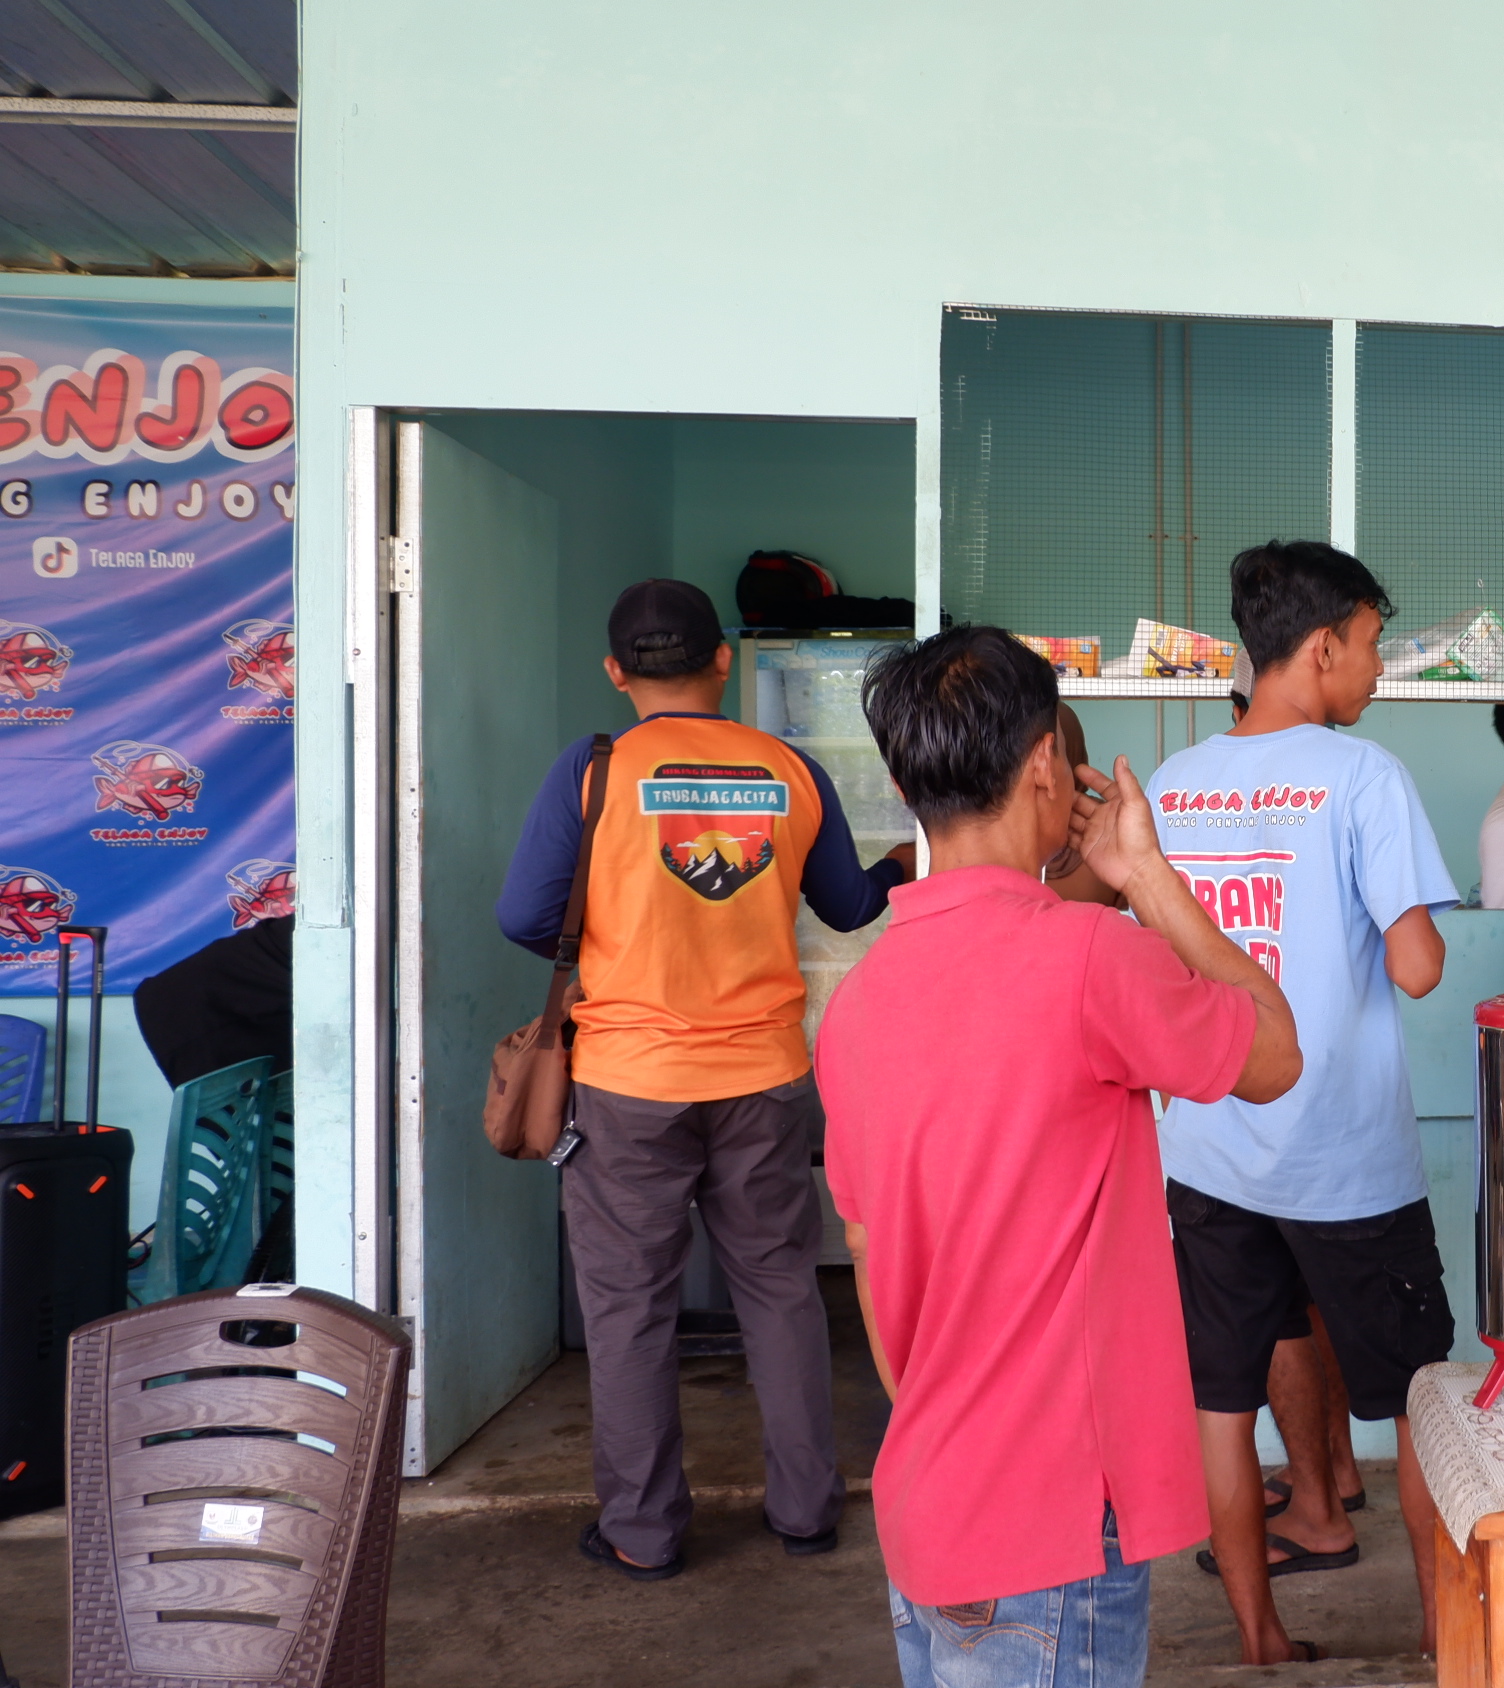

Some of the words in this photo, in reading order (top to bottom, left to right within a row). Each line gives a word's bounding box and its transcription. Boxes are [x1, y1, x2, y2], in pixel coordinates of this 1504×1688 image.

[80, 479, 296, 522] ENJOY
[662, 768, 700, 776] HIKING
[701, 769, 766, 777] COMMUNITY
[1250, 785, 1328, 812] ENJOY
[1167, 816, 1197, 828] YANG
[1264, 814, 1306, 826] ENJOY
[89, 829, 153, 841] TELAGA
[155, 827, 209, 840] ENJOY
